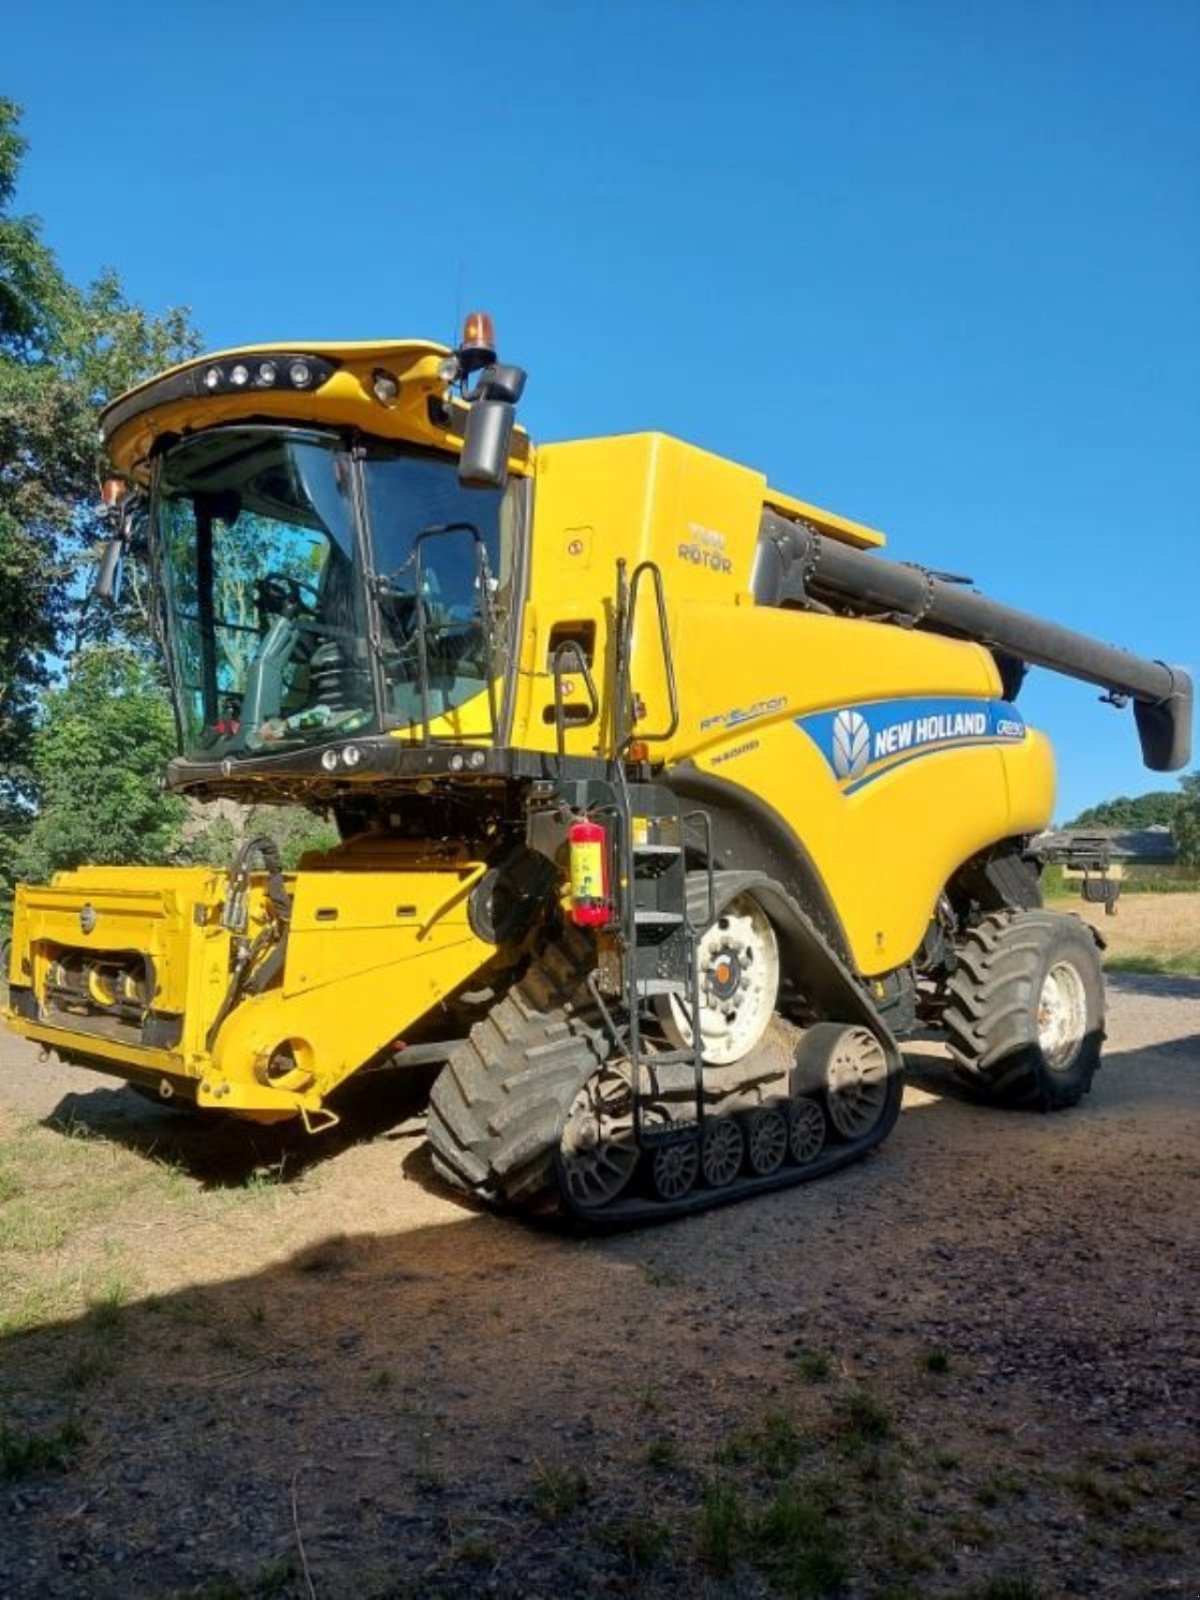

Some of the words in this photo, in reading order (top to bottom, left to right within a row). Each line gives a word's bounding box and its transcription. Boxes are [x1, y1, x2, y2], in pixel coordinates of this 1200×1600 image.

[677, 543, 733, 575] ROTOR
[874, 719, 914, 759] NEW
[915, 712, 987, 744] HOLLAND
